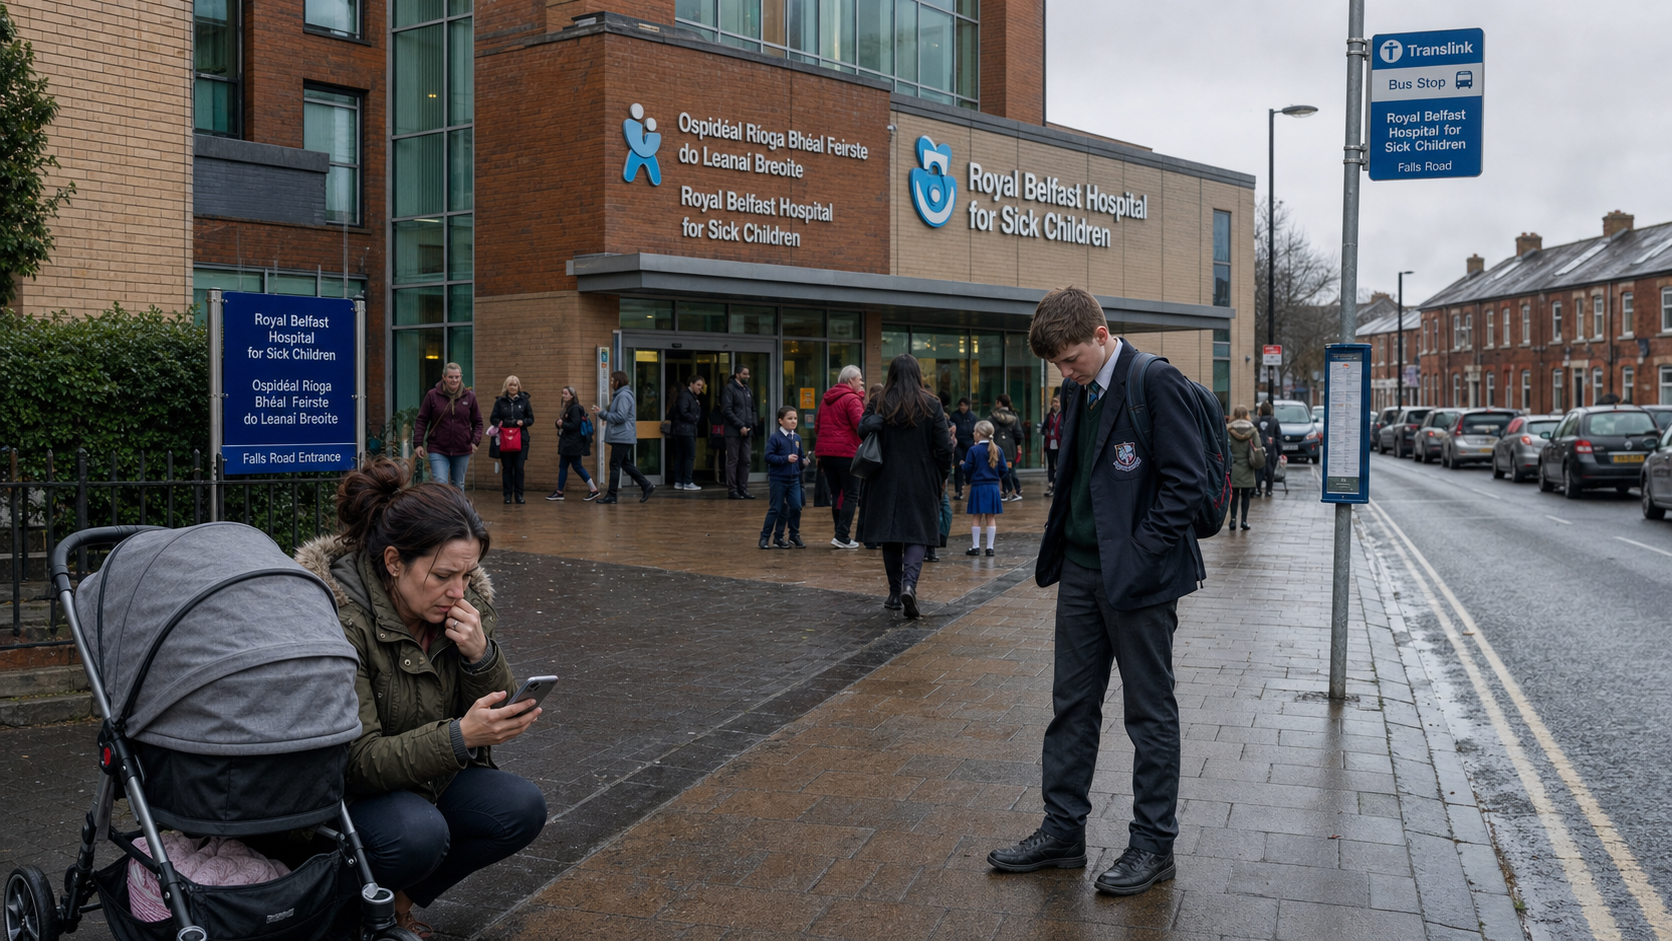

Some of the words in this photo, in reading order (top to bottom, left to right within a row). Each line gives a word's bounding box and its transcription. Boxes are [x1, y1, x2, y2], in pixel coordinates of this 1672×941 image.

[1408, 41, 1473, 57] Translink
[1389, 79, 1412, 90] Bus
[1417, 78, 1445, 89] Stop
[1387, 112, 1420, 125] Royal
[1425, 110, 1466, 121] Belfast
[679, 112, 742, 140] Ospidéal
[746, 123, 784, 151] Ríoga
[788, 130, 824, 153] Bhéal
[827, 136, 869, 160] Feirste
[1389, 126, 1438, 139] Hospital
[1444, 125, 1461, 135] for
[1385, 142, 1410, 153] Sick
[1415, 140, 1466, 151] Children
[679, 143, 699, 164] do
[755, 153, 803, 178] Breoite
[1398, 163, 1421, 172] Falls
[1425, 161, 1452, 171] Road
[969, 162, 1019, 202] Royal
[1023, 172, 1082, 208] Belfast
[1085, 184, 1148, 222] Hospital
[681, 185, 722, 213] Royal
[726, 191, 776, 216] Belfast
[779, 197, 833, 223] Hospital
[969, 200, 996, 231] for
[1001, 205, 1040, 238] Sick
[1044, 211, 1111, 248] Children
[682, 217, 704, 237] for
[708, 219, 739, 241] Sick
[743, 223, 801, 247] Children
[255, 313, 286, 329] Royal
[291, 315, 329, 328] Belfast
[269, 331, 314, 346] Hospital
[247, 346, 263, 358] for
[267, 347, 289, 359] Sick
[293, 348, 336, 361] Children
[252, 379, 299, 394] Ospidéal
[255, 396, 286, 408] Bhéal
[292, 396, 329, 408] Feirste
[244, 413, 257, 425] do
[300, 413, 338, 424] Breoite
[243, 453, 266, 464] Falls
[270, 452, 295, 463] Road
[299, 452, 341, 463] Entrance
